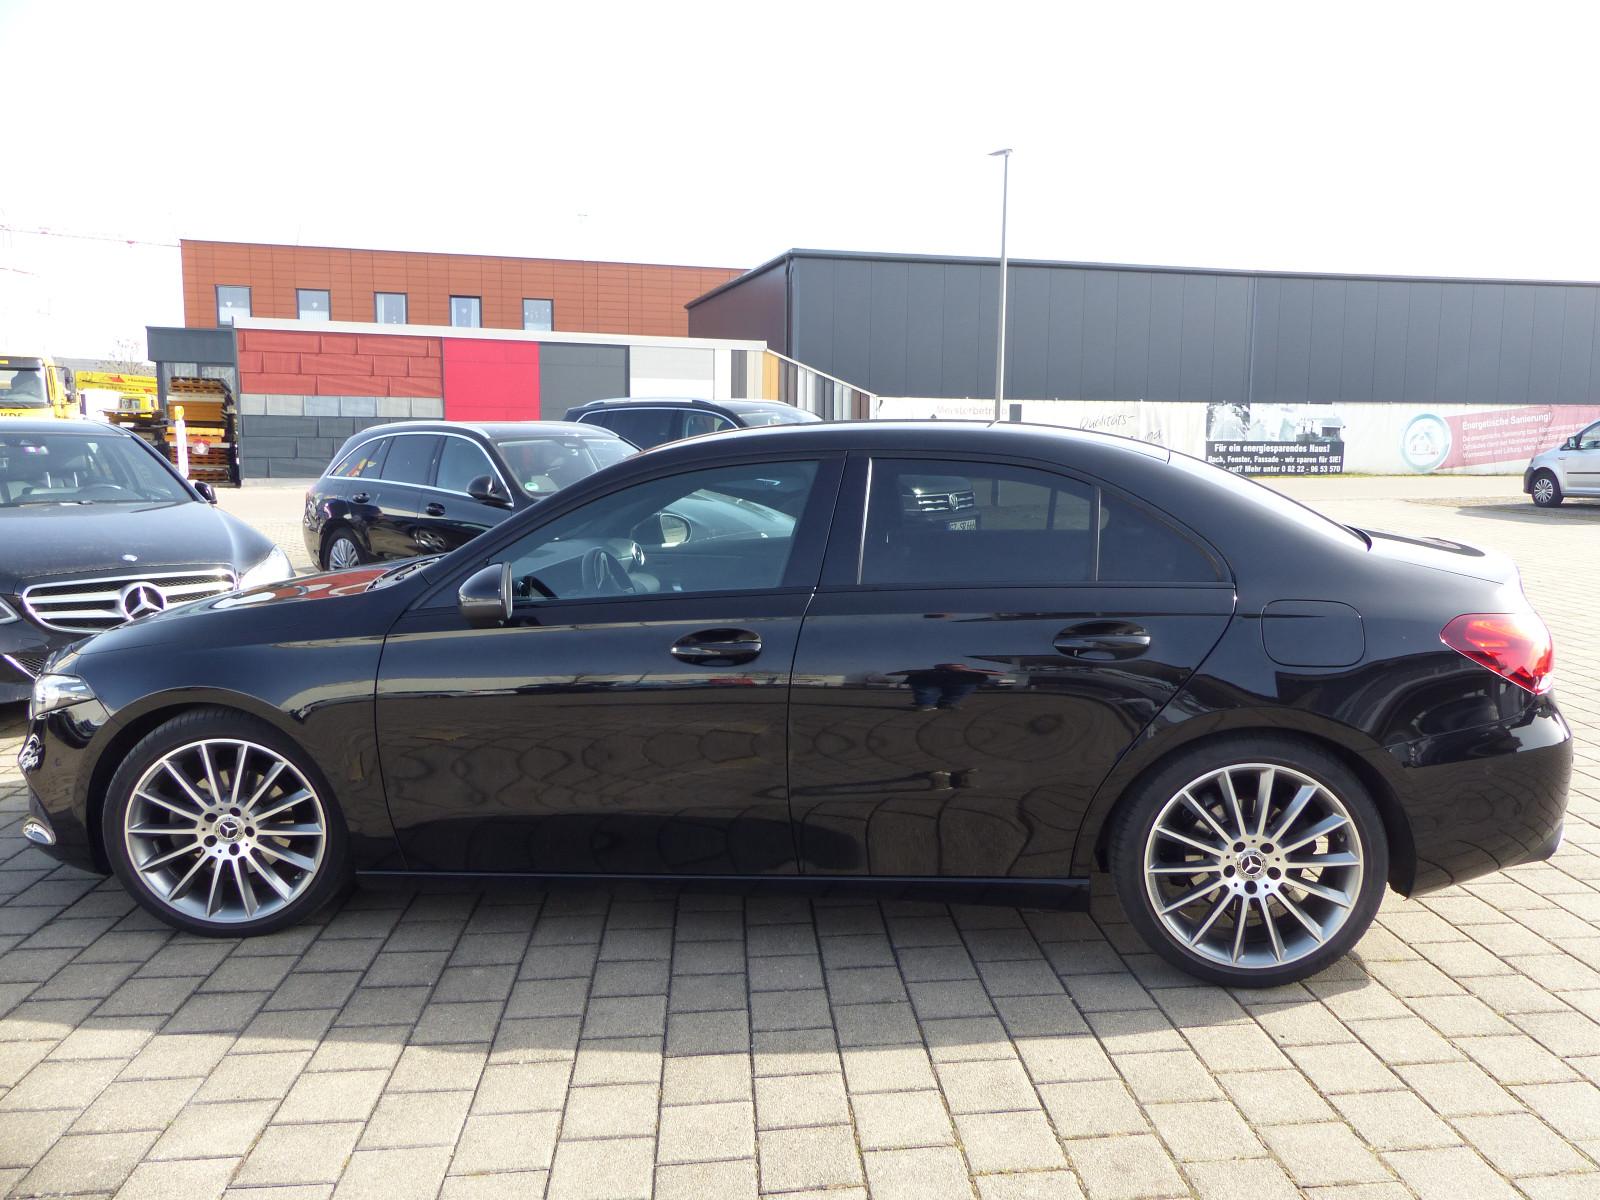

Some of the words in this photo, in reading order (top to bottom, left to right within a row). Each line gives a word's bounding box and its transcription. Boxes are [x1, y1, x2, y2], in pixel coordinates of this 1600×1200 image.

[1462, 417, 1508, 430] Energetische
[1510, 412, 1551, 425] Sanierung!
[1214, 443, 1227, 452] Für
[1228, 443, 1241, 452] ein
[1243, 443, 1307, 454] energiesparendes
[1309, 444, 1330, 453] Haus!
[1207, 455, 1225, 464] Dach,
[1227, 455, 1252, 464] Fenster,
[1254, 455, 1279, 463] Fassade
[1318, 455, 1328, 463] für
[1329, 455, 1342, 463] SIE!
[1244, 465, 1261, 473] Mehr
[1262, 465, 1280, 473] unter
[1296, 465, 1305, 473] 22
[1329, 465, 1341, 473] 570
